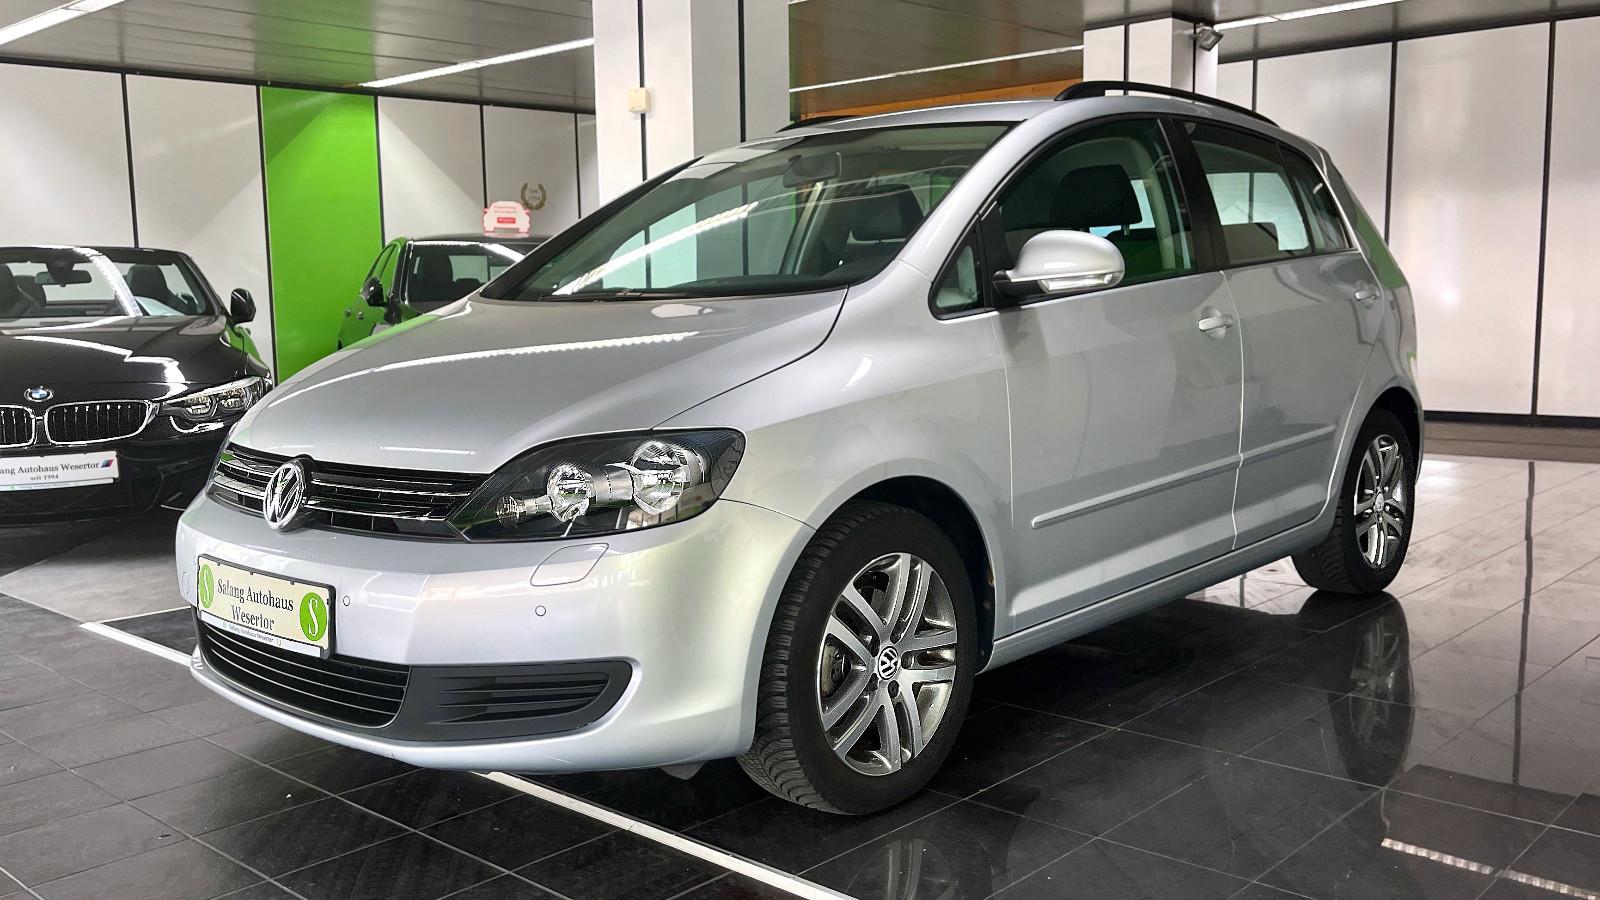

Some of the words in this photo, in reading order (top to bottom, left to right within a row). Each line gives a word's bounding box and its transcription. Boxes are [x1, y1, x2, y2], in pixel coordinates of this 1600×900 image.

[18, 465, 58, 474] Autohaus
[61, 462, 99, 471] Wesertor
[217, 578, 245, 604] Salang
[246, 586, 294, 612] Autohaus
[231, 604, 275, 631] Wesertor
